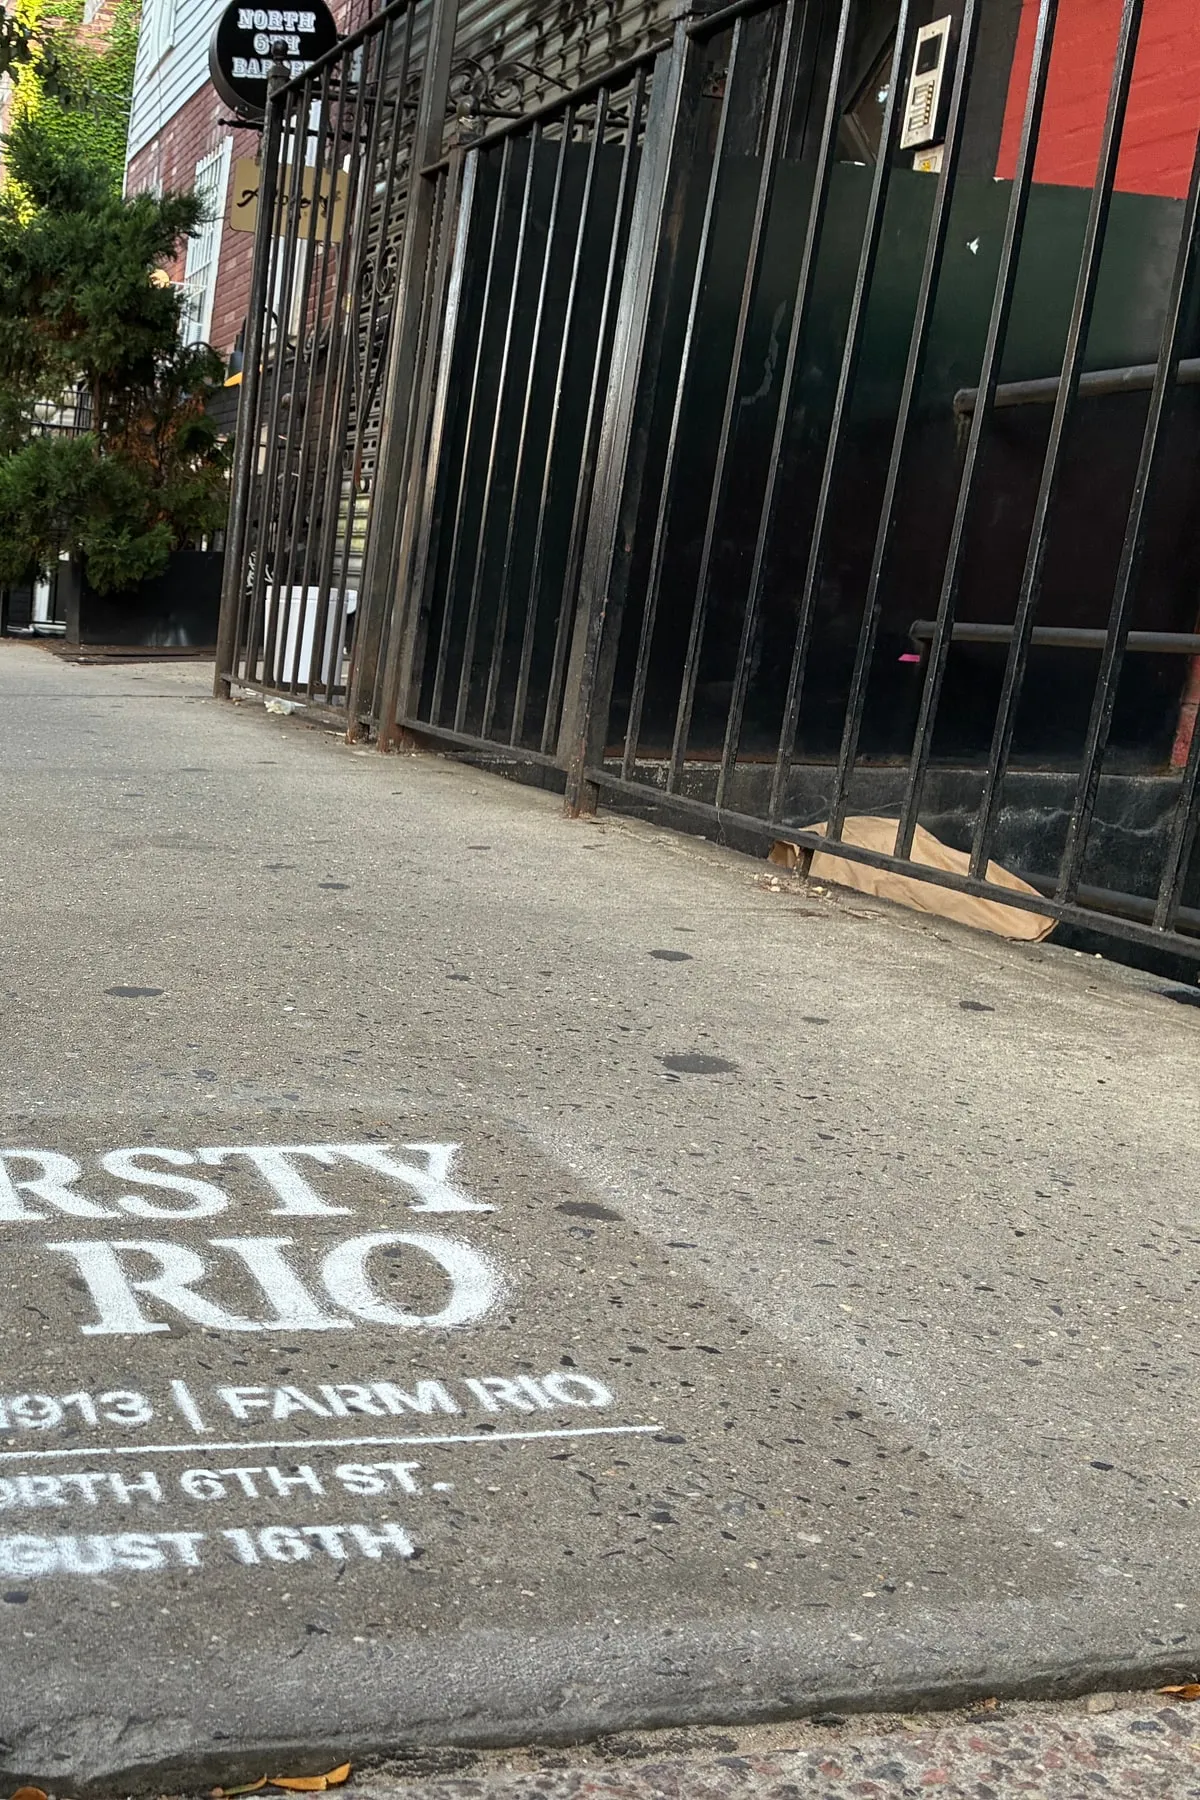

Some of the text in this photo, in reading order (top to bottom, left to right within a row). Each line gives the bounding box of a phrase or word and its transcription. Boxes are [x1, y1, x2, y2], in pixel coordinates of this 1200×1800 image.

[237, 8, 316, 32] NORTH
[46, 1231, 505, 1334] RIO
[216, 1380, 461, 1420] FARM
[465, 1371, 616, 1414] RIO
[179, 1464, 325, 1500] 6TH
[335, 1461, 455, 1496] ST.
[219, 1523, 418, 1565] 16TH
